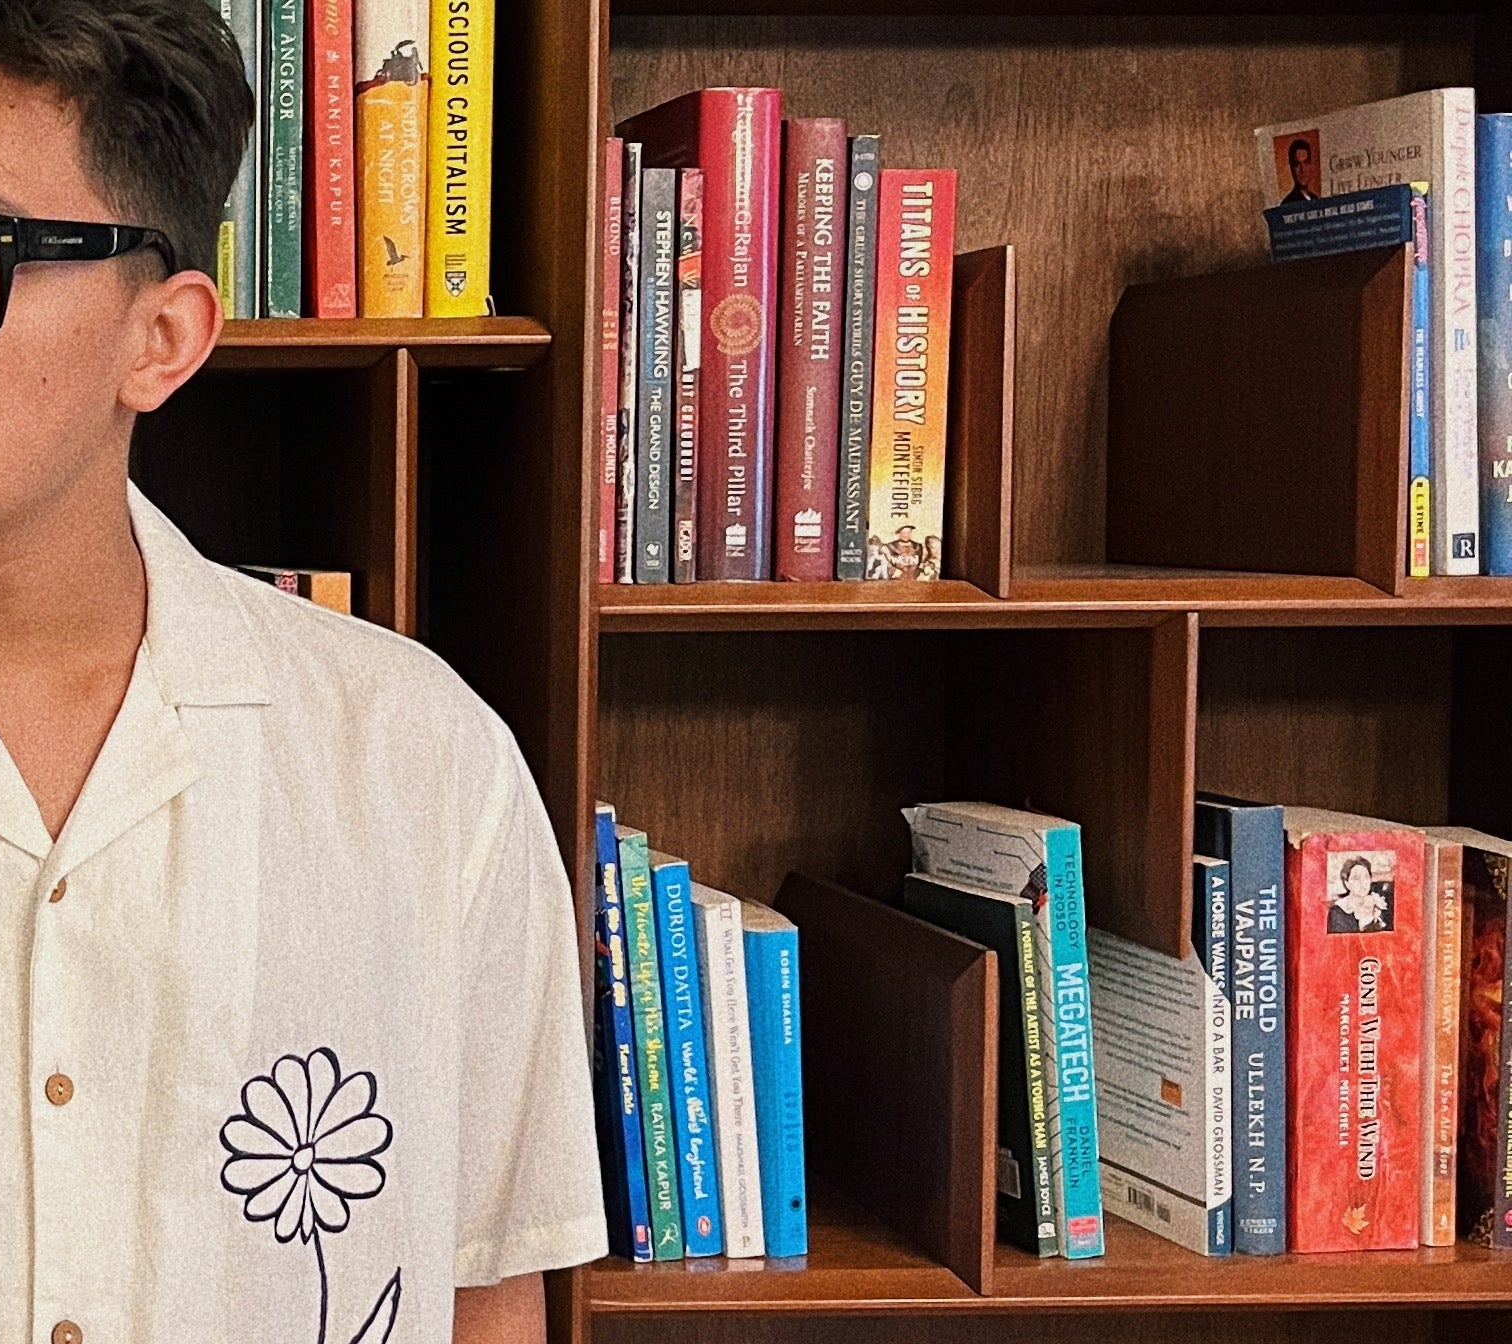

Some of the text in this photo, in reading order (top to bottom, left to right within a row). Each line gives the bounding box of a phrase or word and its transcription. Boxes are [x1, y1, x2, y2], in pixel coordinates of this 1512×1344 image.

[280, 33, 295, 121] ANGKOR
[446, 96, 468, 236] CAPITALISM
[1365, 144, 1422, 167] YOUNGER
[654, 211, 672, 378] STEPHEN HAWKING
[811, 159, 833, 361] KEEPING THE FAITH
[894, 182, 932, 425] TITANS OF HISTORY
[648, 387, 662, 509] THE GRAND DESIGN
[727, 360, 748, 518] The Third Pillar
[890, 431, 908, 520] MONTEFIORE
[667, 884, 693, 1031] DURJOY DATTA
[782, 985, 792, 1045] SHARMA
[1235, 900, 1254, 1021] VAJPAYEE
[1259, 884, 1276, 1033] THE UNTOLD
[1056, 962, 1088, 1103] MEGATECH
[651, 1103, 670, 1210] RATIKA KAPUR
[1066, 1118, 1078, 1190] FRANKLIN
[1078, 1126, 1091, 1176] DANIEL
